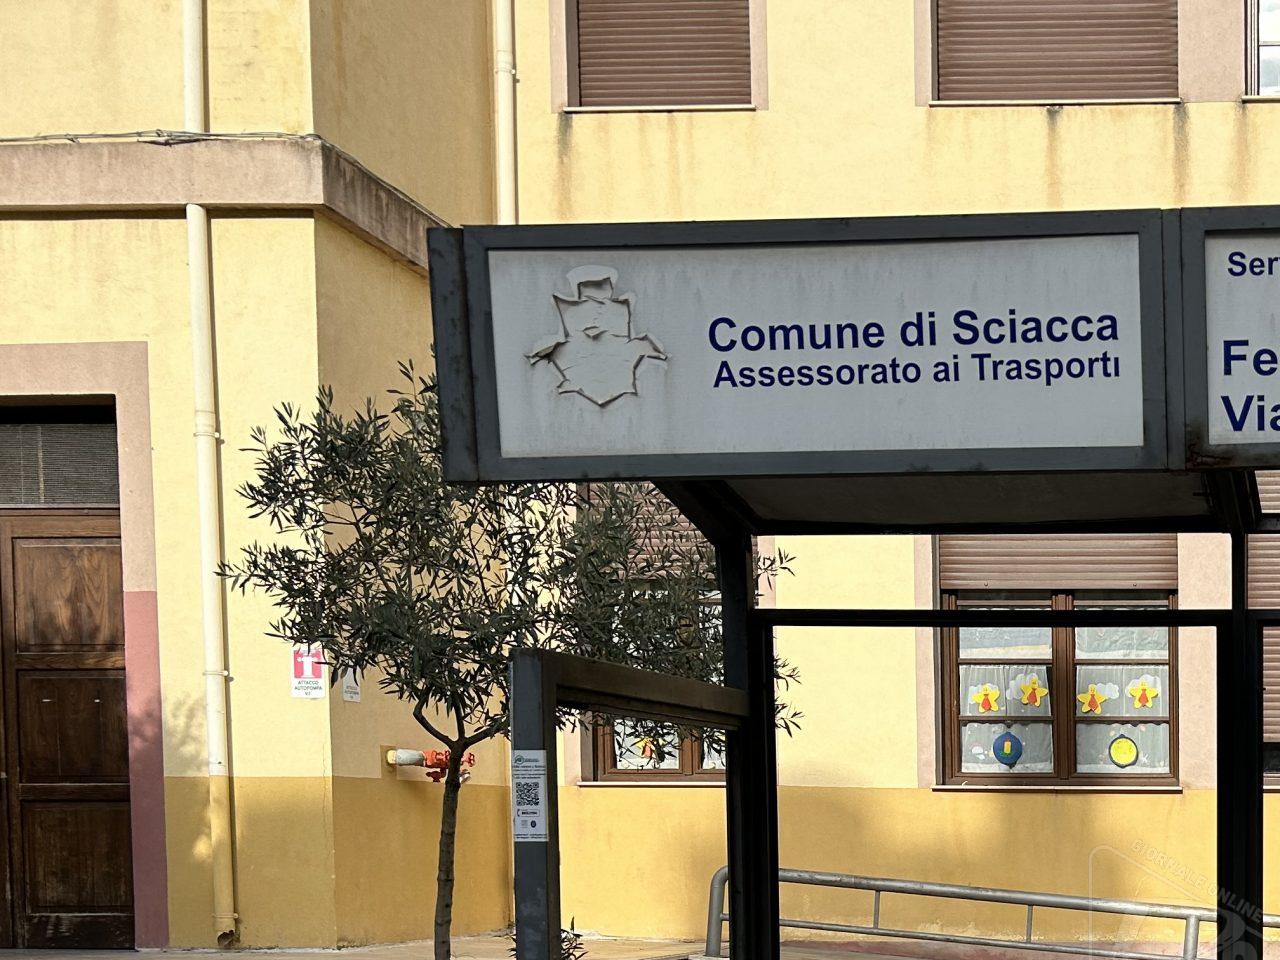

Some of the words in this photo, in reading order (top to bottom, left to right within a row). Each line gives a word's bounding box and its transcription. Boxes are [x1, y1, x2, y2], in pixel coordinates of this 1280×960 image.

[708, 316, 885, 353] Comune
[900, 311, 937, 347] di
[952, 308, 1119, 346] Sciacca
[713, 356, 922, 388] Assessorato
[933, 354, 960, 383] ai
[970, 350, 1120, 387] Trasporti
